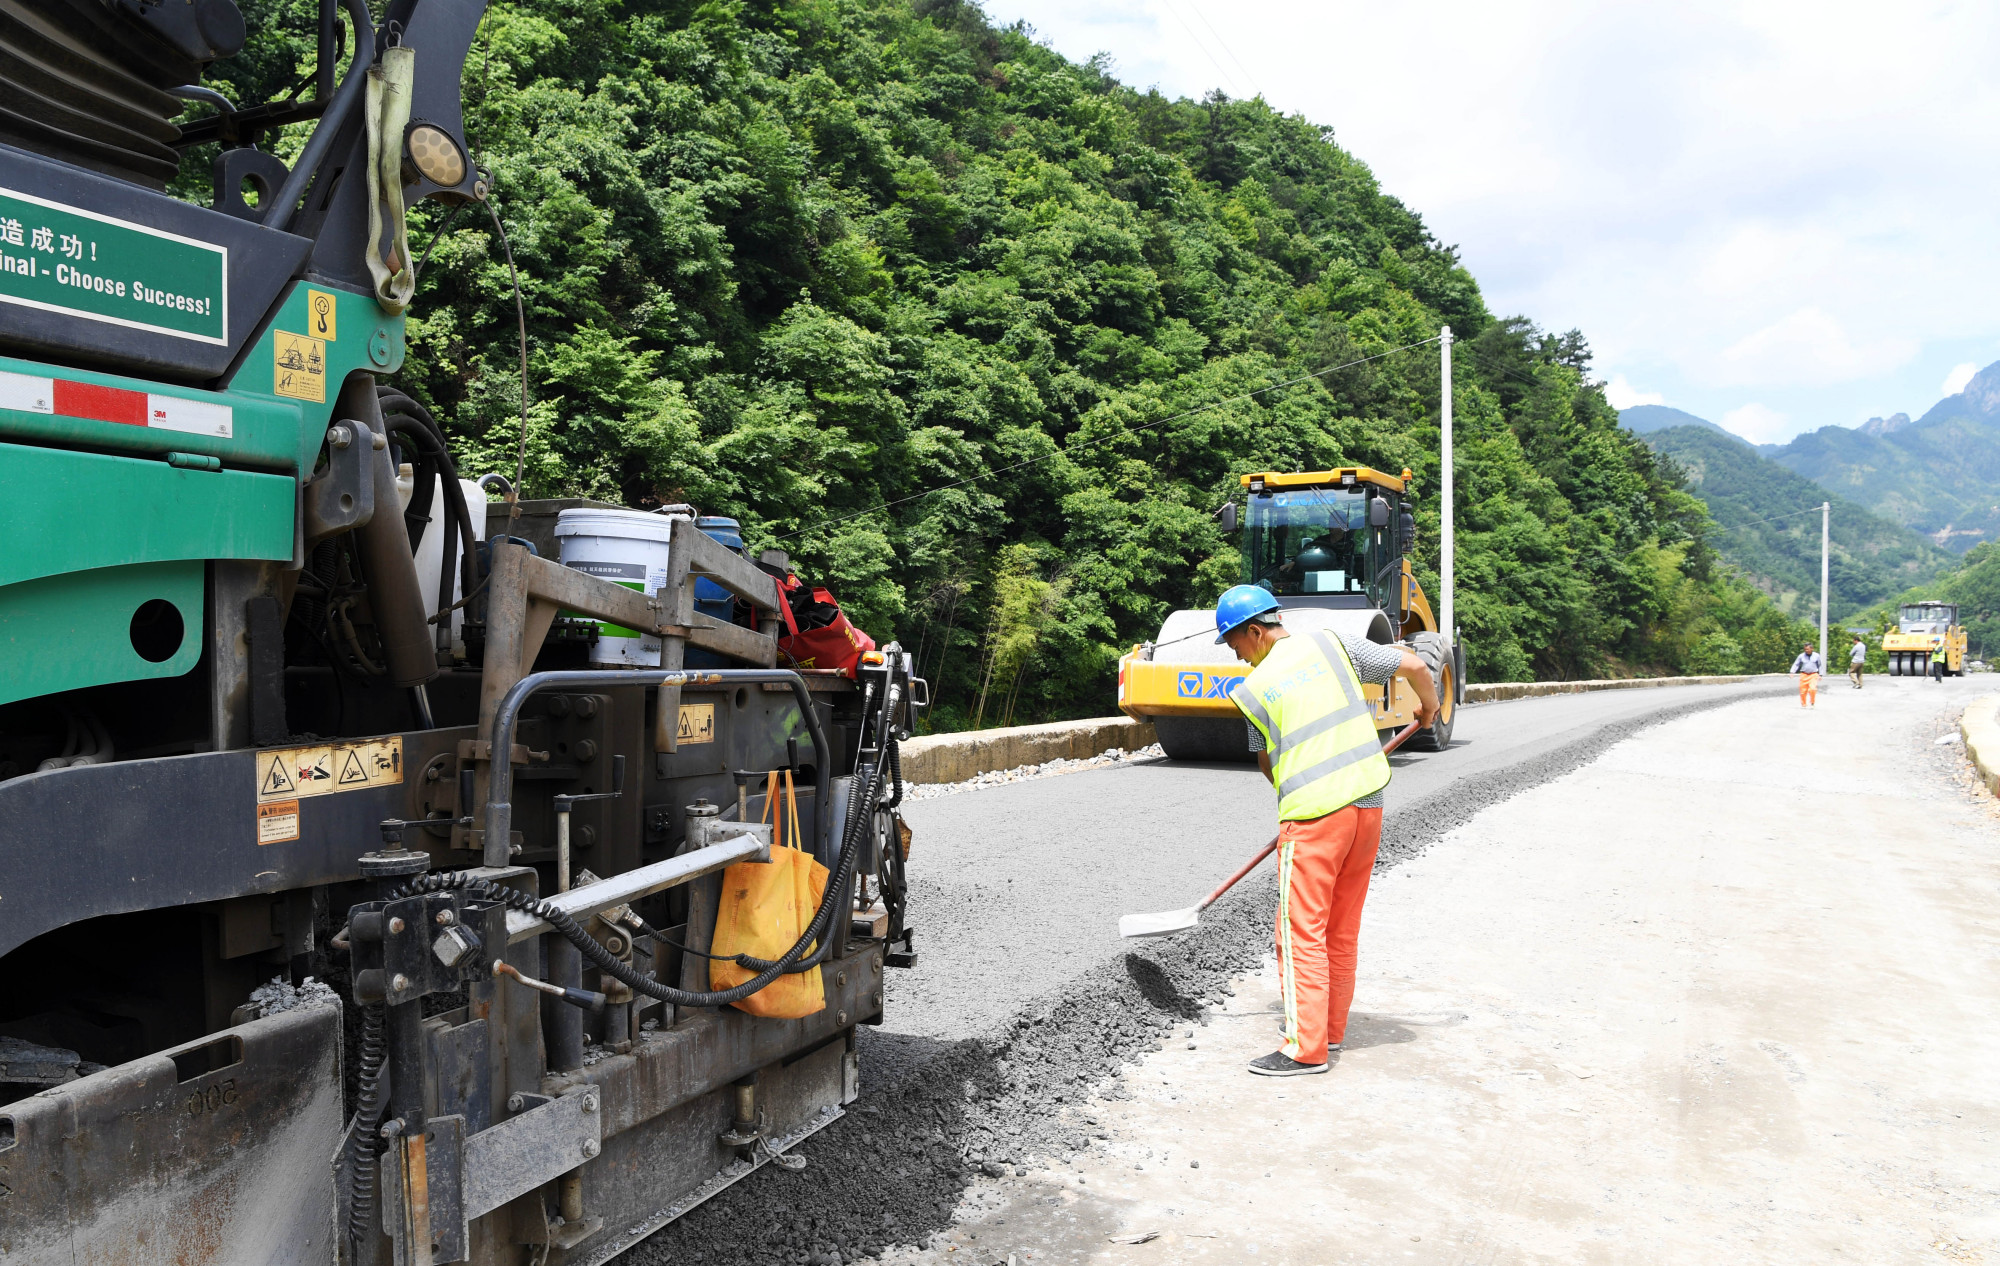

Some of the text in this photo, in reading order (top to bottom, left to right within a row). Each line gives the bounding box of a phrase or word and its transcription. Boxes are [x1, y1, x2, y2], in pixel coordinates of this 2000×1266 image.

[56, 263, 126, 297] Choose
[133, 280, 210, 316] Success!
[153, 410, 166, 419] 3M
